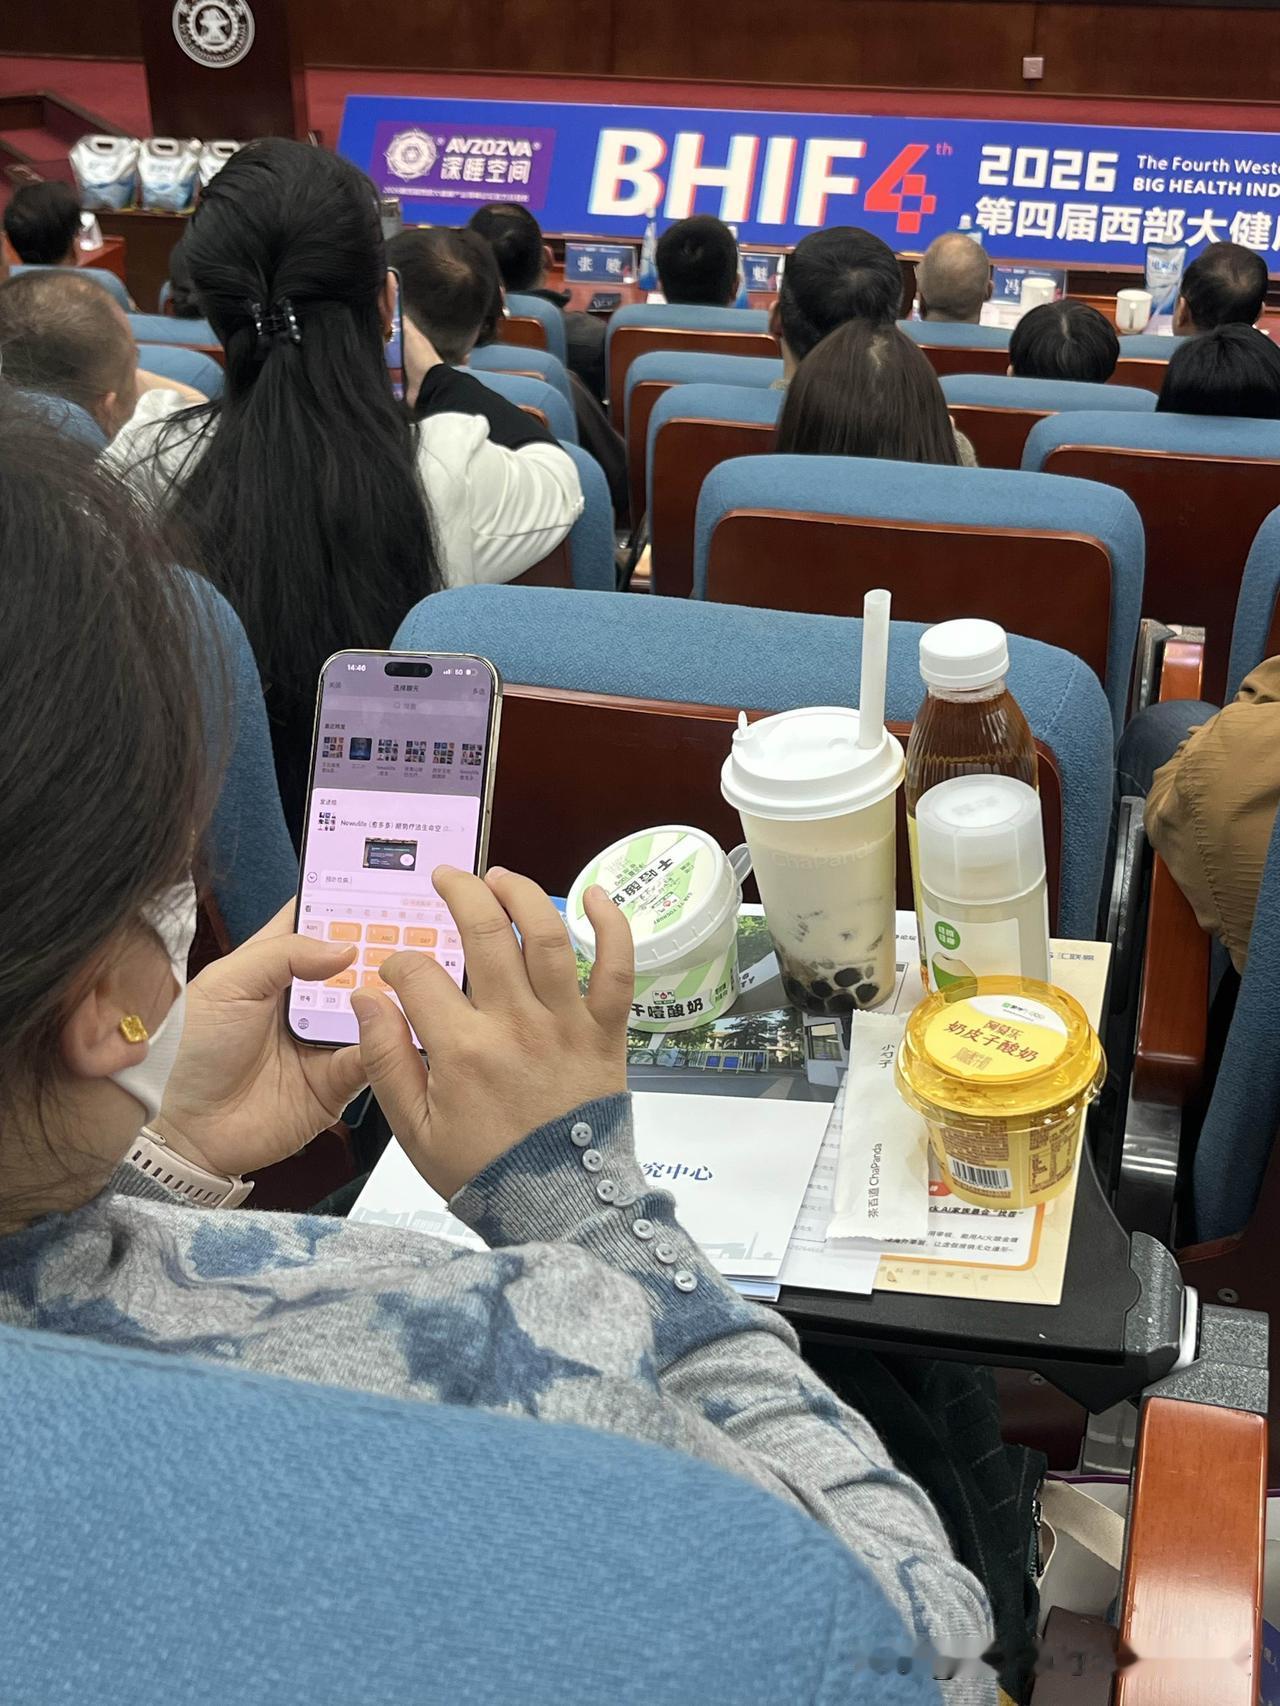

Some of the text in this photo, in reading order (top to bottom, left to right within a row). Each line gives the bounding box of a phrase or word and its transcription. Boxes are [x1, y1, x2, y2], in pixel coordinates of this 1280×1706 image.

[588, 127, 867, 226] BHIF
[978, 144, 1119, 192] 2026
[1133, 177, 1165, 193] BIG
[1169, 178, 1242, 196] HEALTH
[1137, 154, 1168, 170] The
[1172, 156, 1230, 173] Fourth
[975, 196, 1280, 251] 第四届西部大健
[944, 1020, 1039, 1062] 奶皮子酸奶
[868, 1143, 883, 1218] 茶百道 ChaPanda
